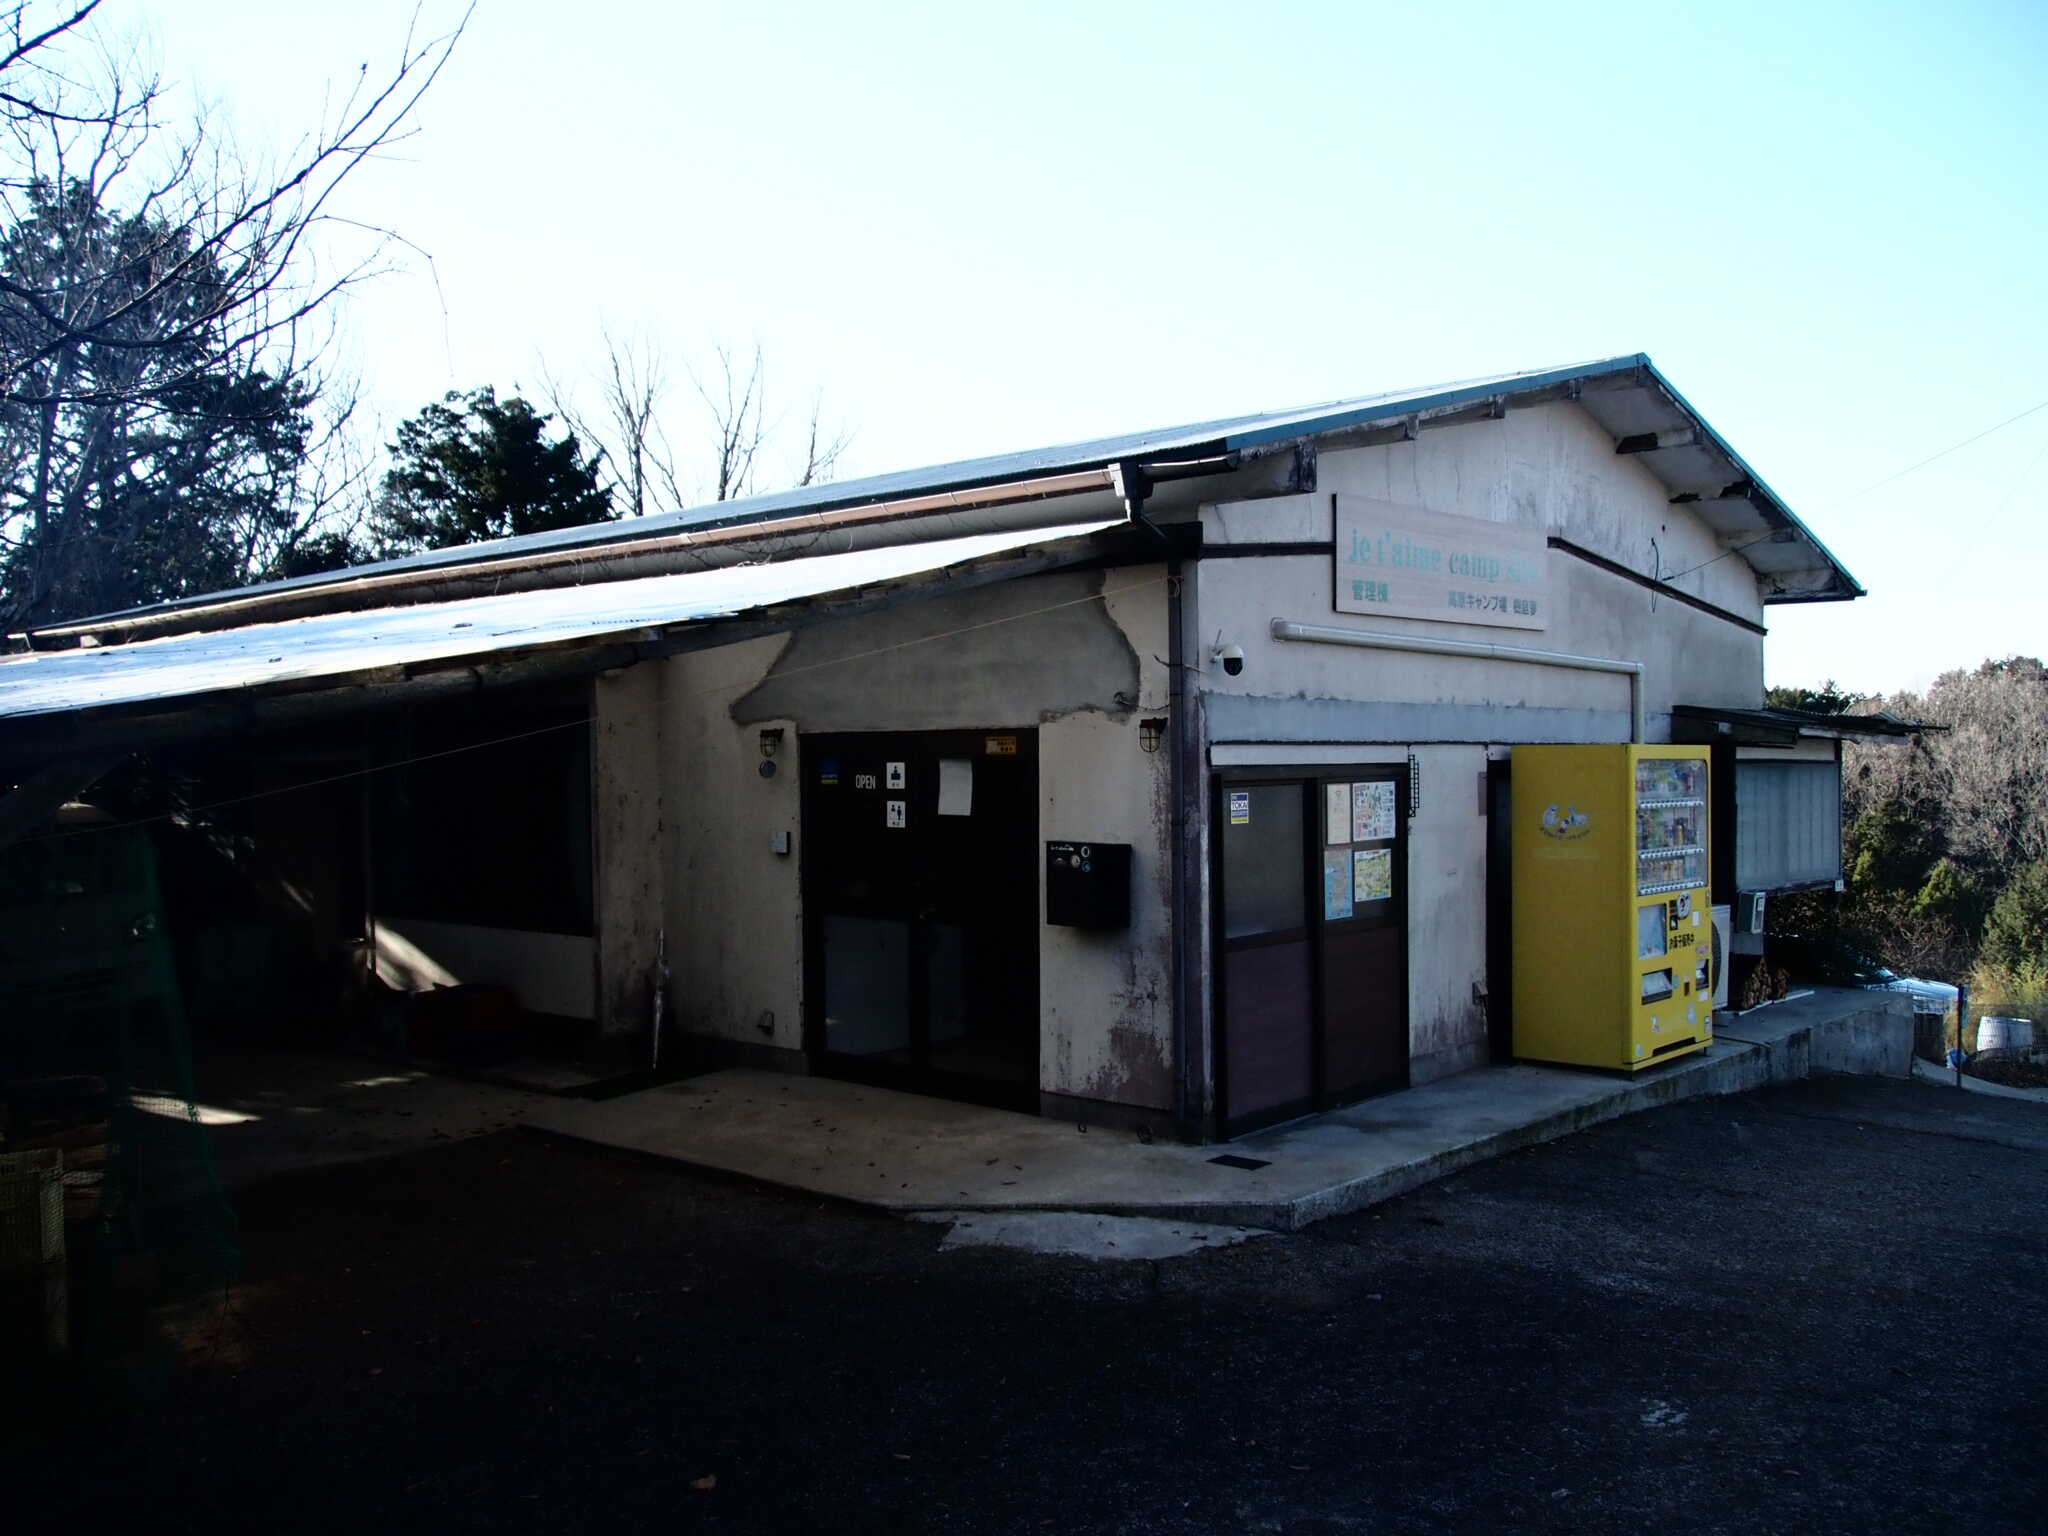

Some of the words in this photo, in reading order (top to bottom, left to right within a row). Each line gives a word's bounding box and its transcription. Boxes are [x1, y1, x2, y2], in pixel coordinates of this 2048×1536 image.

[1349, 528, 1370, 561] je
[1376, 530, 1441, 572] t'aime
[1448, 551, 1500, 583] camp
[855, 774, 876, 789] OPEN
